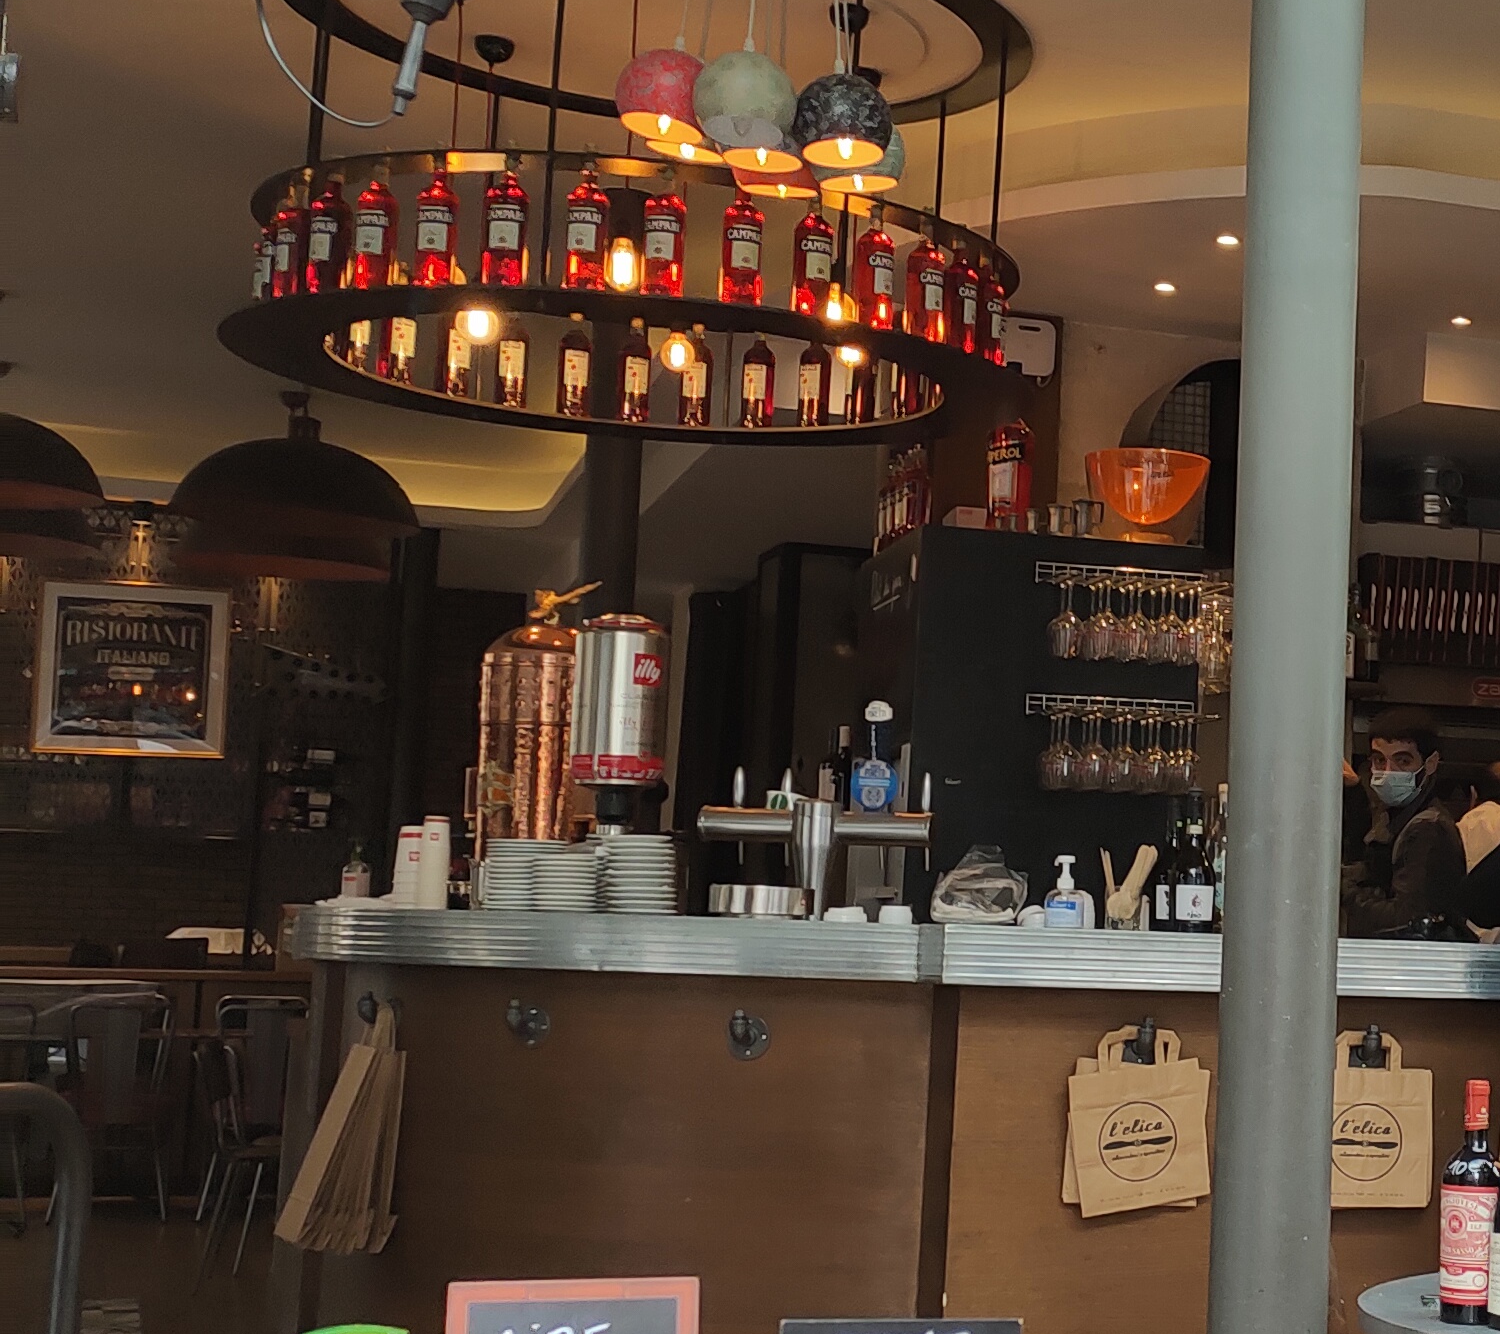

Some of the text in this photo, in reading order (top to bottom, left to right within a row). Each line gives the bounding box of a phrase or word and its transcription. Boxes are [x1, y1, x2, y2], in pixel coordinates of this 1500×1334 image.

[96, 649, 171, 666] ITALIANO
[634, 658, 661, 684] illy
[1109, 1118, 1164, 1138] l'elica
[1338, 1119, 1393, 1136] l'elica
